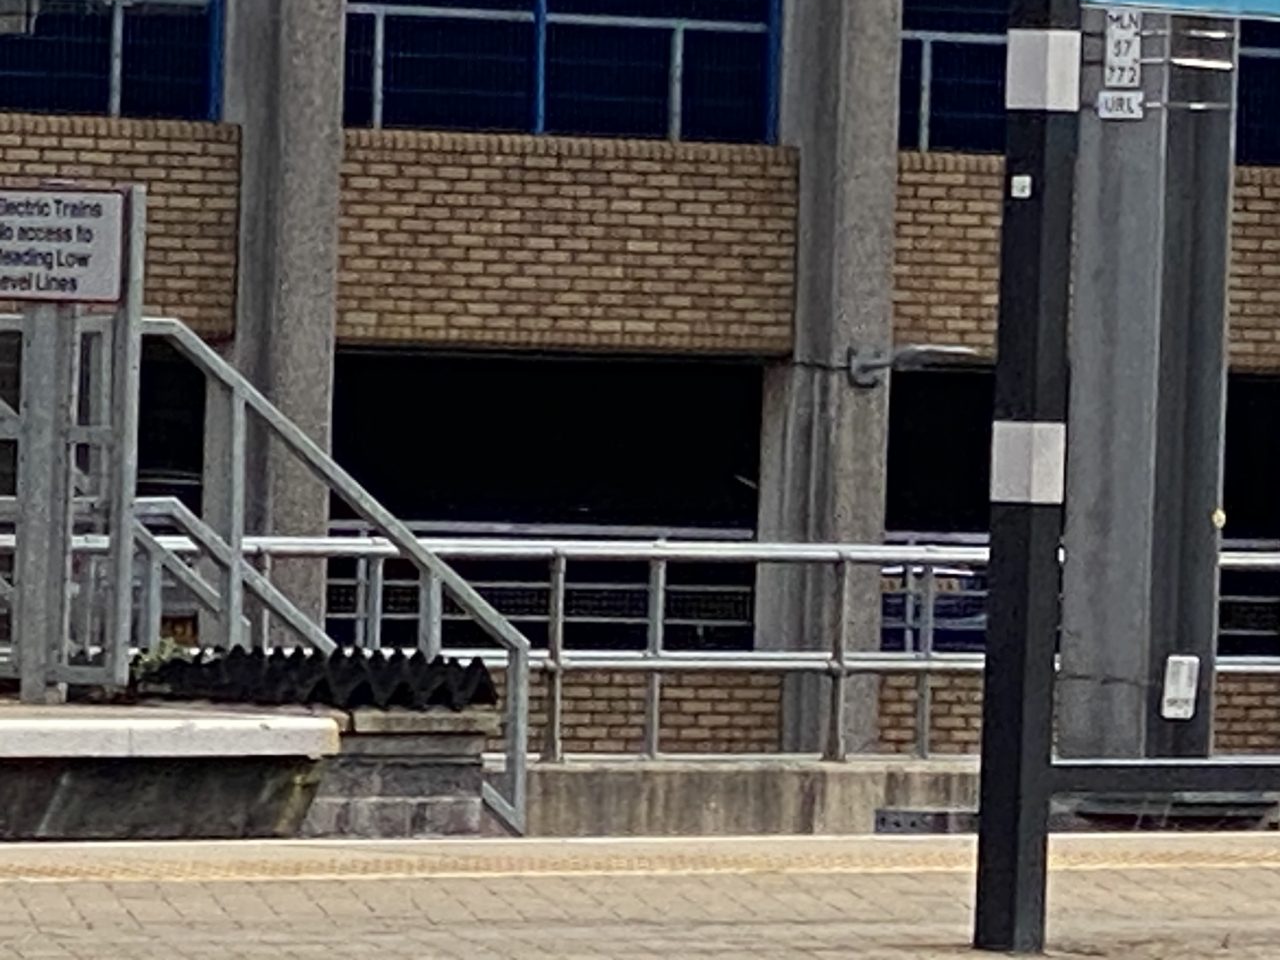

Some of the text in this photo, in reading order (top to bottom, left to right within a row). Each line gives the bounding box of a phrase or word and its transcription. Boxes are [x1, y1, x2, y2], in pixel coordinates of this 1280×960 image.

[53, 198, 102, 218] Trains
[18, 227, 72, 242] access
[76, 225, 93, 243] to
[56, 249, 92, 268] Low
[36, 272, 77, 292] Lines
